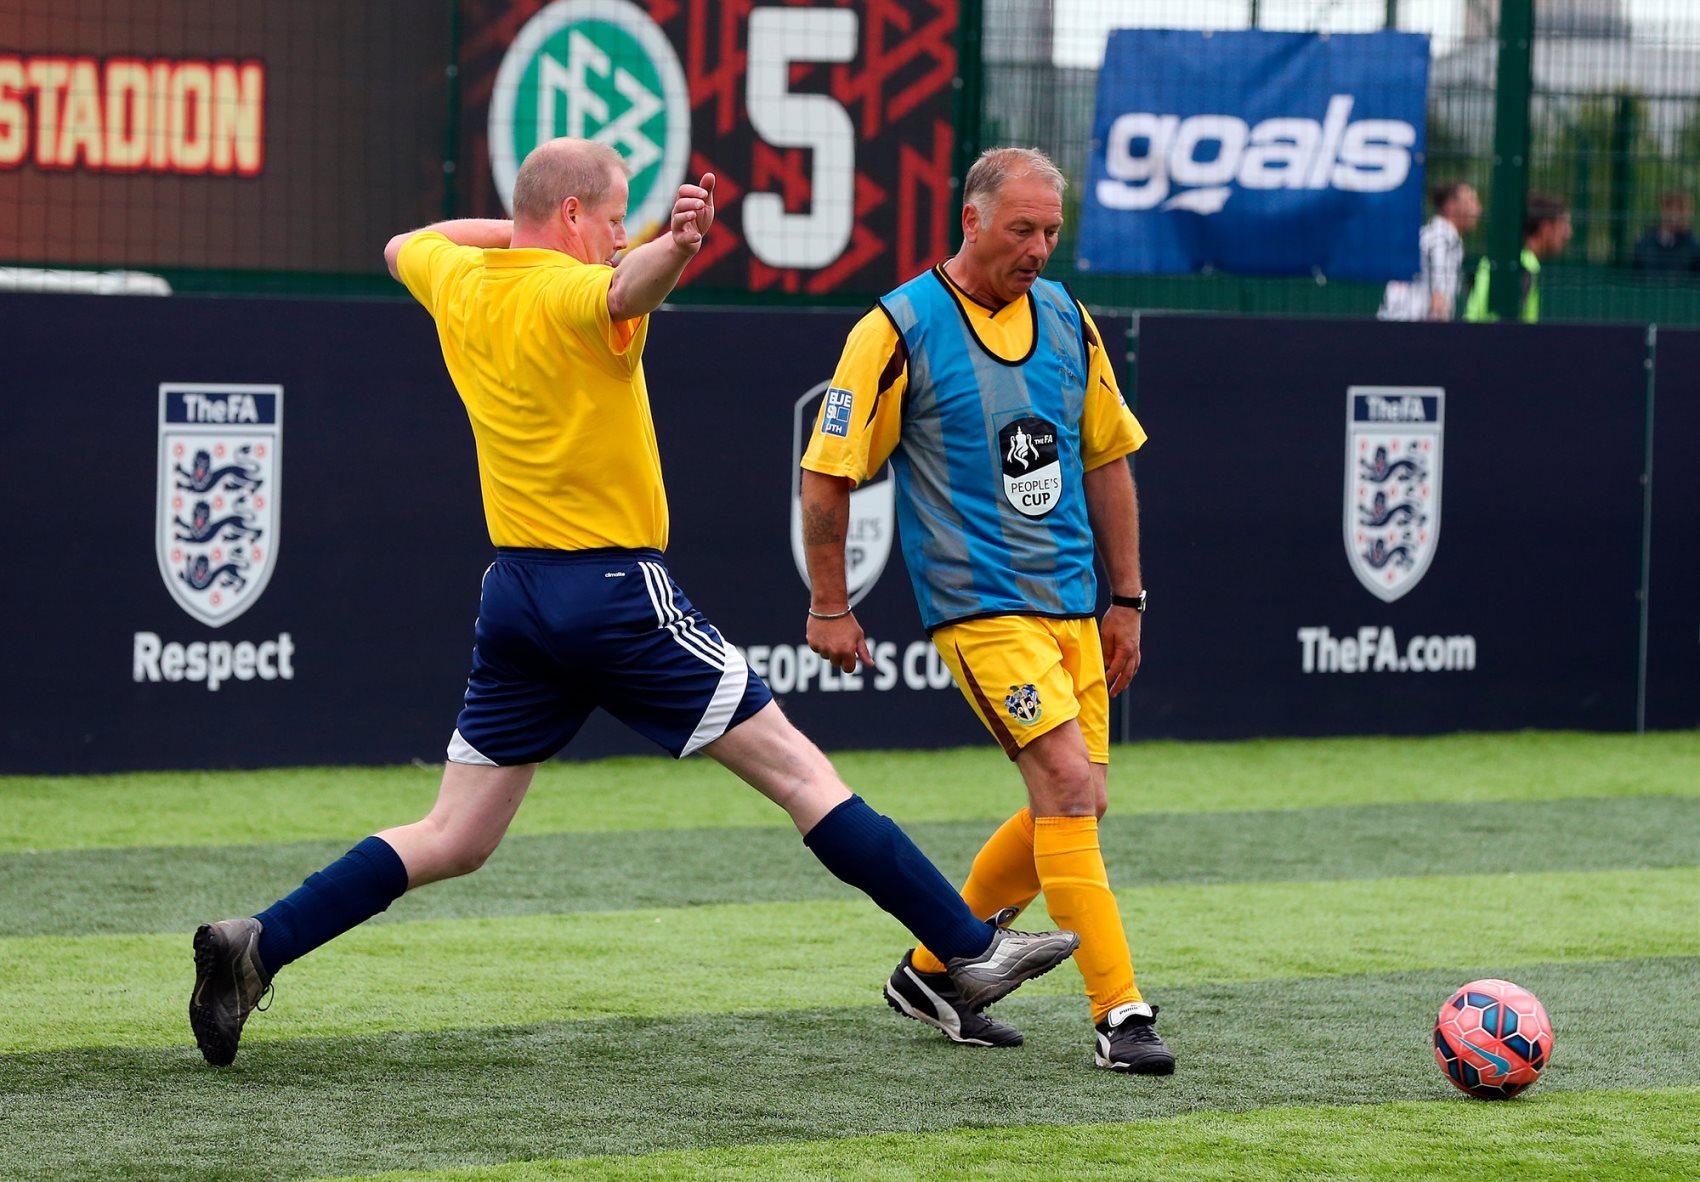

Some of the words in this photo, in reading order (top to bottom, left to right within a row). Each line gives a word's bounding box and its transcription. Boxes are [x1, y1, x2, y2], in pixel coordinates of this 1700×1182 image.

[0, 58, 263, 175] STADION
[742, 7, 858, 269] 5
[1096, 94, 1416, 211] goals
[1011, 478, 1059, 494] PEOPLE'S
[1022, 492, 1051, 507] CUP
[133, 631, 294, 692] Respect
[736, 638, 898, 694] EOPLE'S
[903, 640, 958, 690] CU
[1297, 625, 1477, 674] TheFA.com
